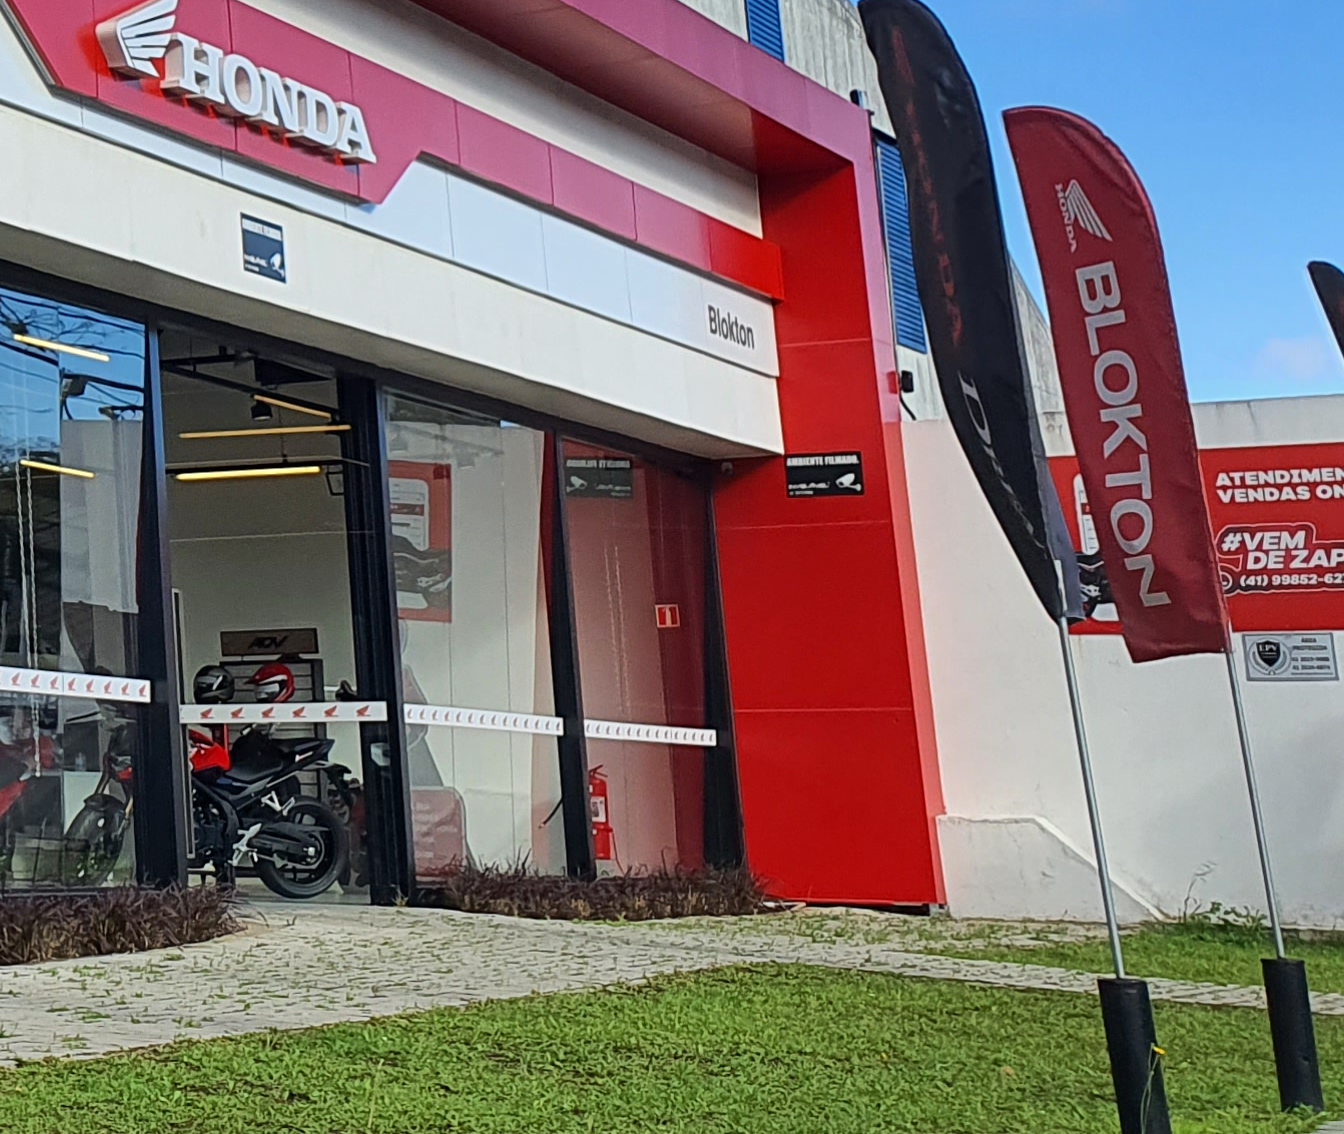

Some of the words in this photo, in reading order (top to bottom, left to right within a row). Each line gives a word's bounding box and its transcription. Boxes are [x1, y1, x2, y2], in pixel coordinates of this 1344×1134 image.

[162, 32, 377, 164] HONDA
[1054, 182, 1078, 254] HONDA
[707, 303, 755, 350] Blokton
[1075, 260, 1173, 608] BLOKTON
[1216, 486, 1311, 504] VENDAS
[1221, 530, 1306, 552] #VEM
[1247, 550, 1286, 570] DE
[1289, 548, 1344, 569] ZAP
[1240, 574, 1269, 587] (41)
